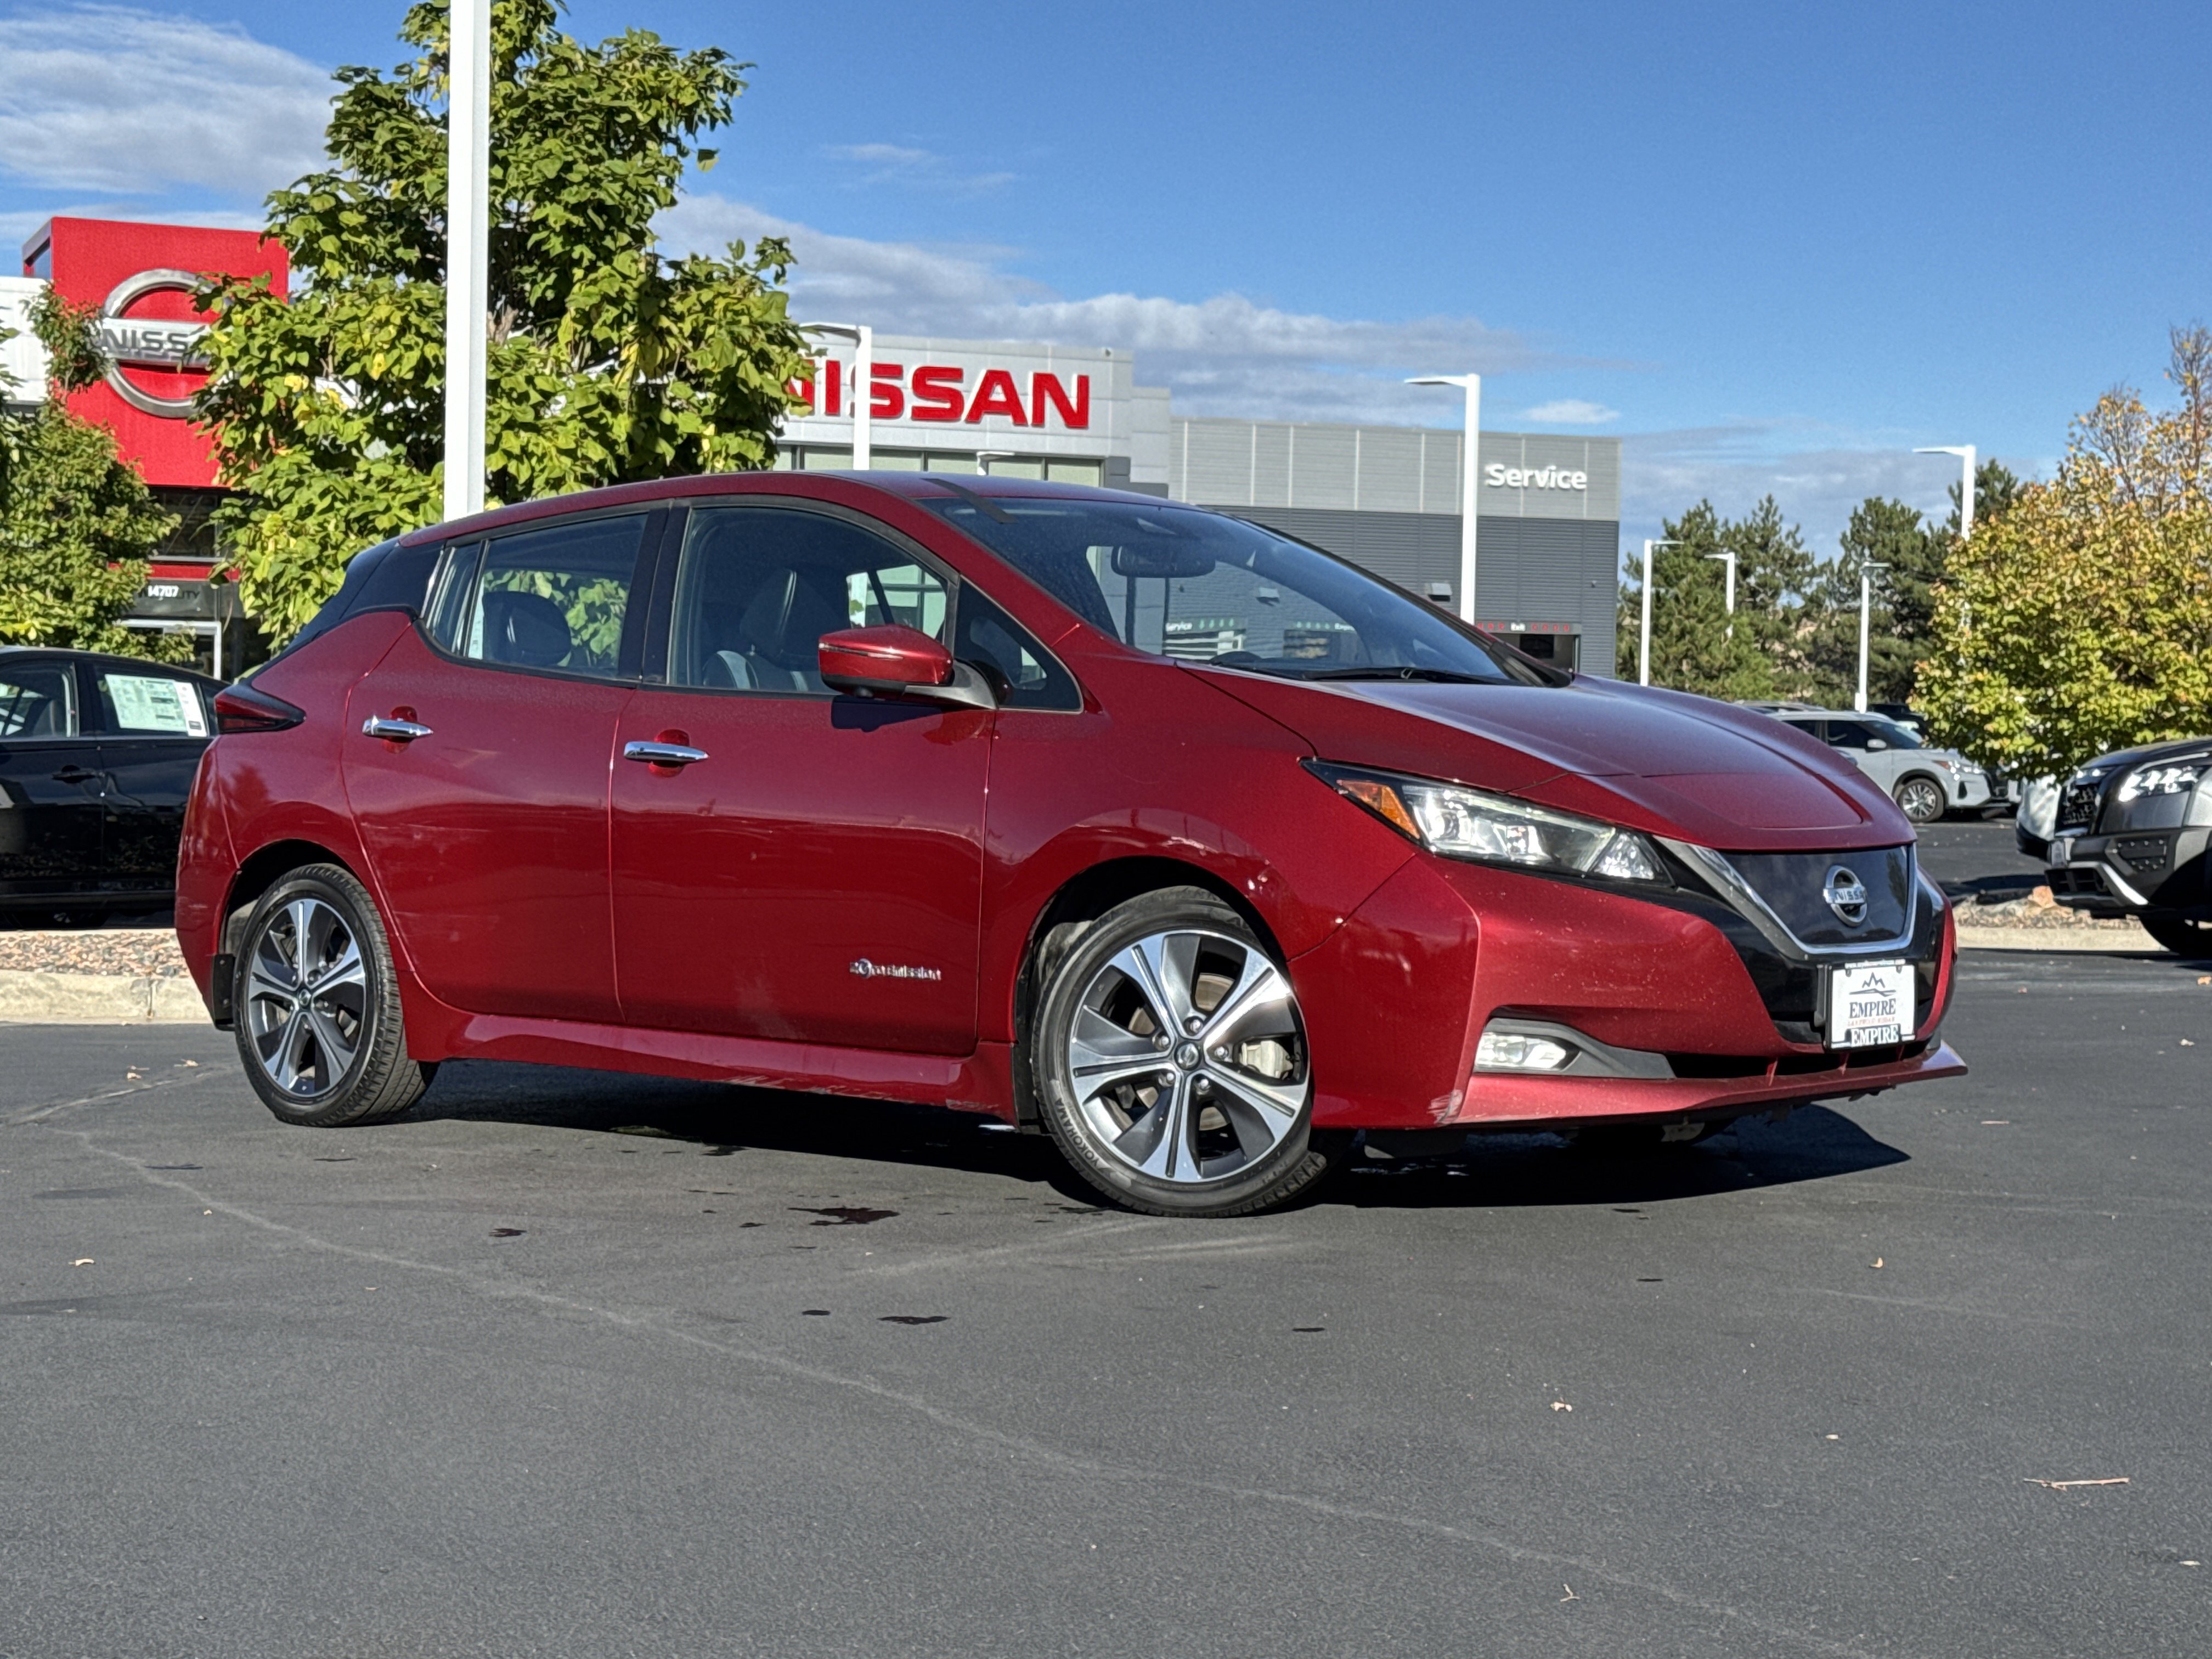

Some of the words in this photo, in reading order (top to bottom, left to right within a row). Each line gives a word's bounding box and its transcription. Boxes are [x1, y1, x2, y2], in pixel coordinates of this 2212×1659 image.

[101, 329, 189, 353] NISS
[1485, 464, 1587, 489] Service
[1849, 998, 1897, 1019] EMPIRE
[1850, 1024, 1899, 1047] EMPIRE
[1054, 1098, 1100, 1167] YOKOHAMA
